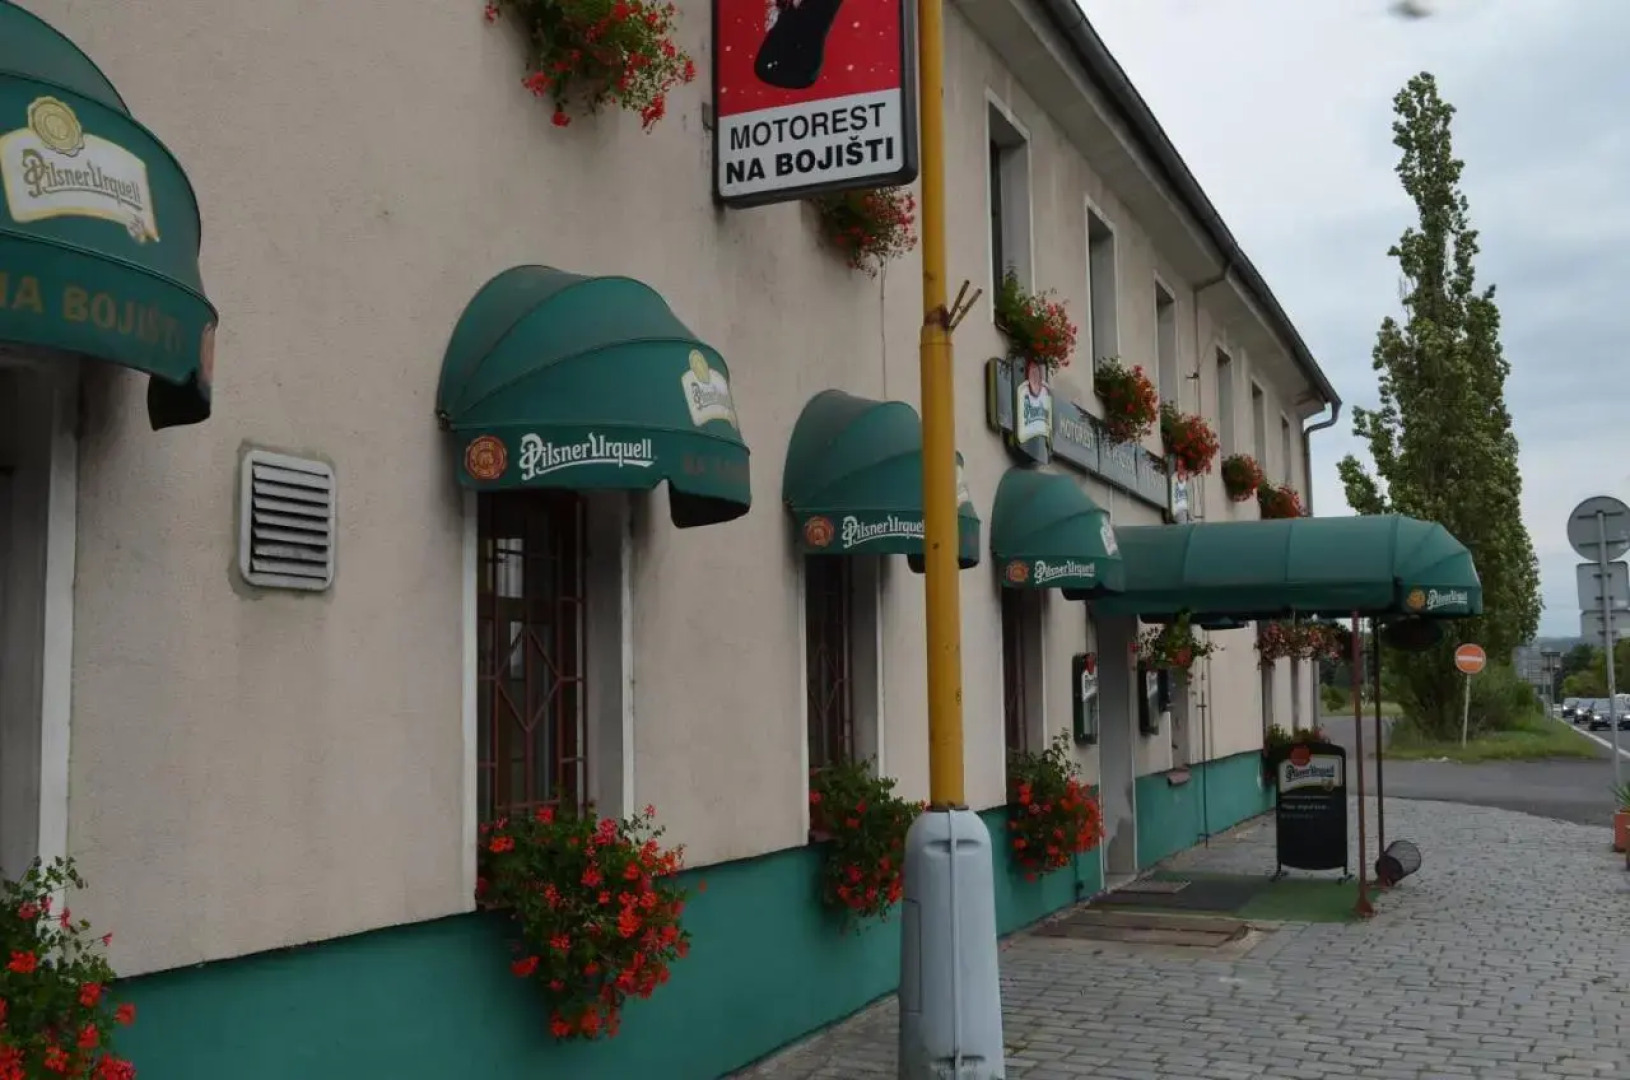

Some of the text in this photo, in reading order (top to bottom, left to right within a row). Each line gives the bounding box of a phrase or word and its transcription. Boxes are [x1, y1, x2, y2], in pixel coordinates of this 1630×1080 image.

[730, 102, 886, 151] MOTOREST
[22, 148, 142, 206] Pilsner Urquell
[726, 135, 895, 185] NA BOJIŠTI
[519, 432, 591, 481] Pilsner
[587, 431, 653, 468] Urquell
[841, 514, 926, 549] Pilsner Urquel
